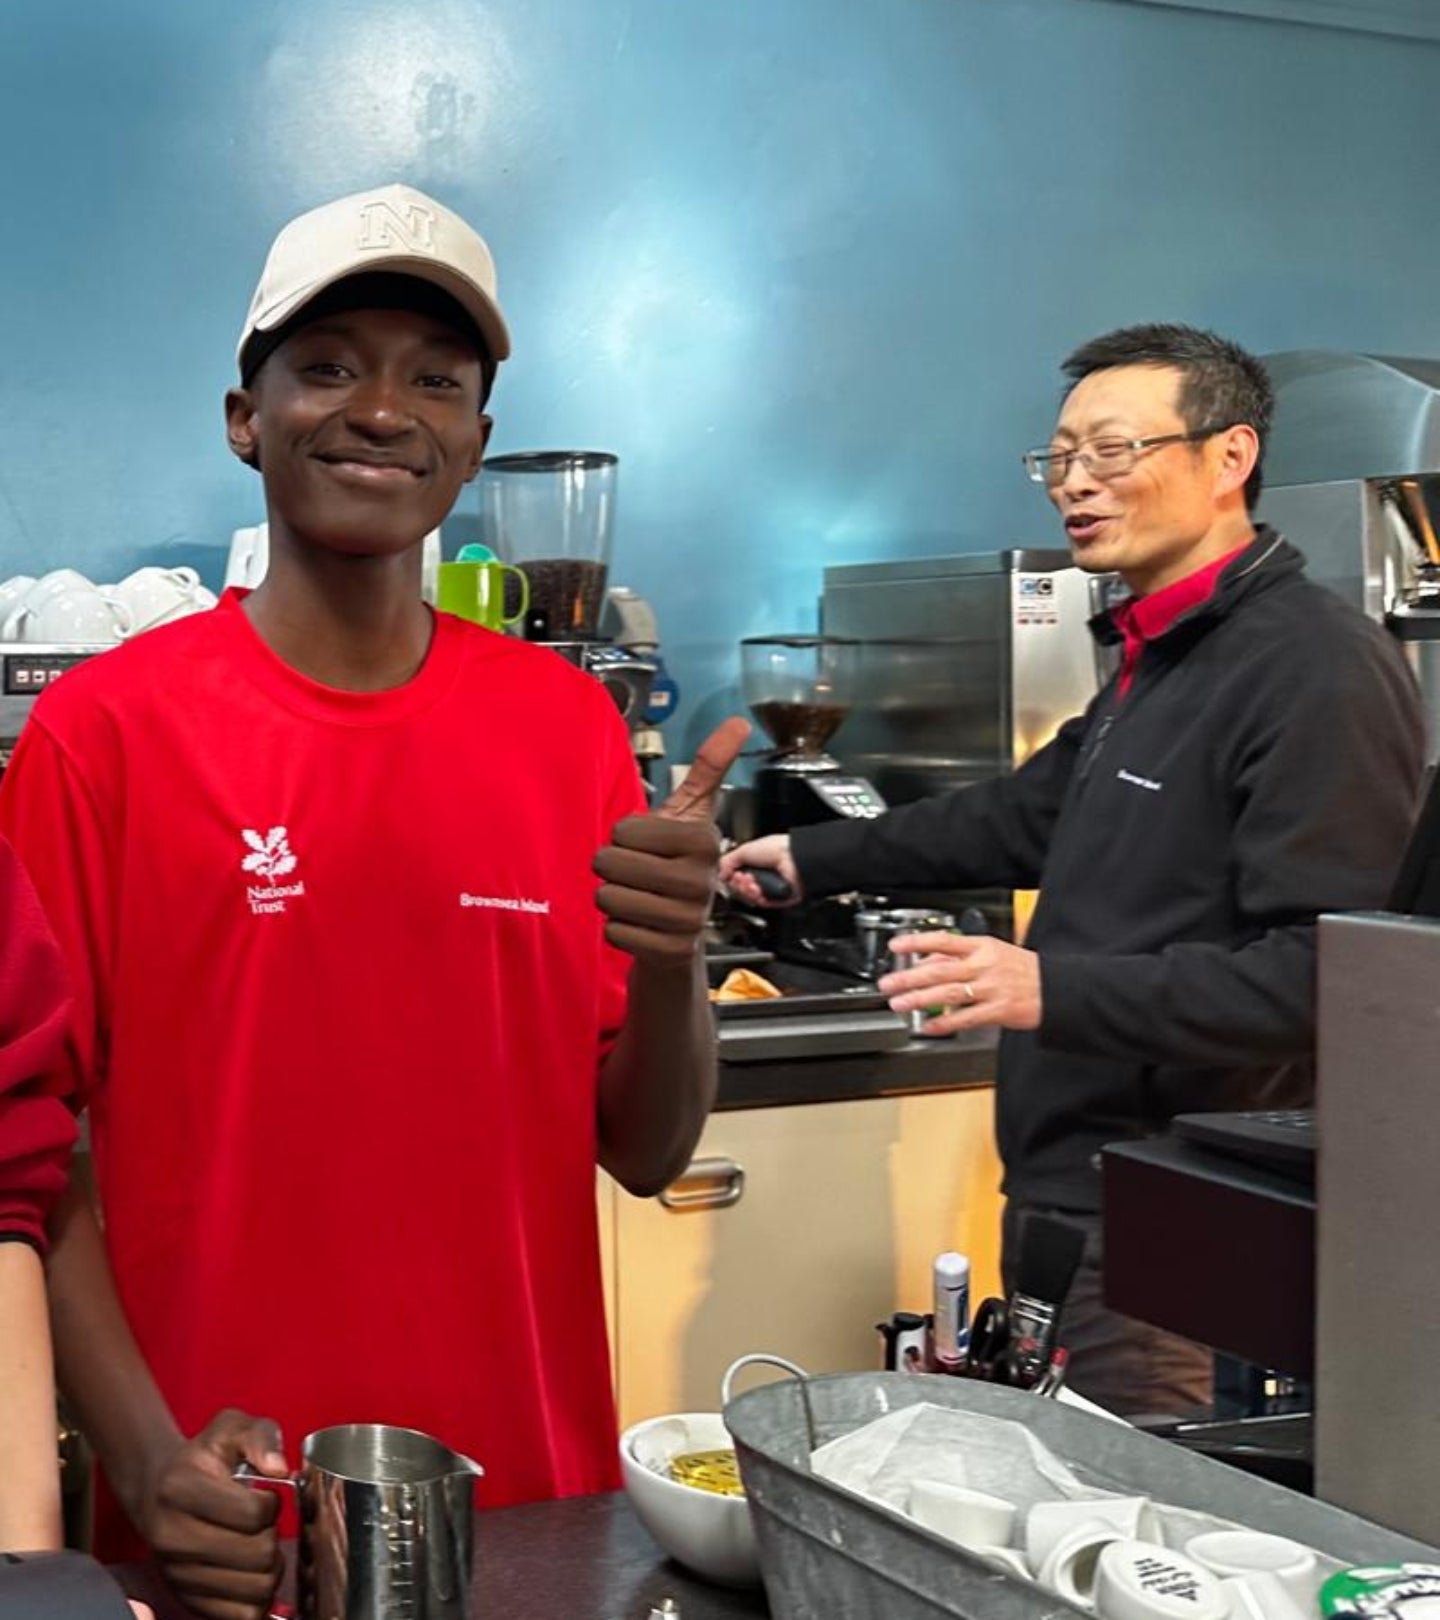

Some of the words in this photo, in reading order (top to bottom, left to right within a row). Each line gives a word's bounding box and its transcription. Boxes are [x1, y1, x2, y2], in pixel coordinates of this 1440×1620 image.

[359, 202, 435, 254] N
[247, 881, 304, 903] National
[460, 893, 520, 911] Brownsea
[252, 900, 286, 914] Trust
